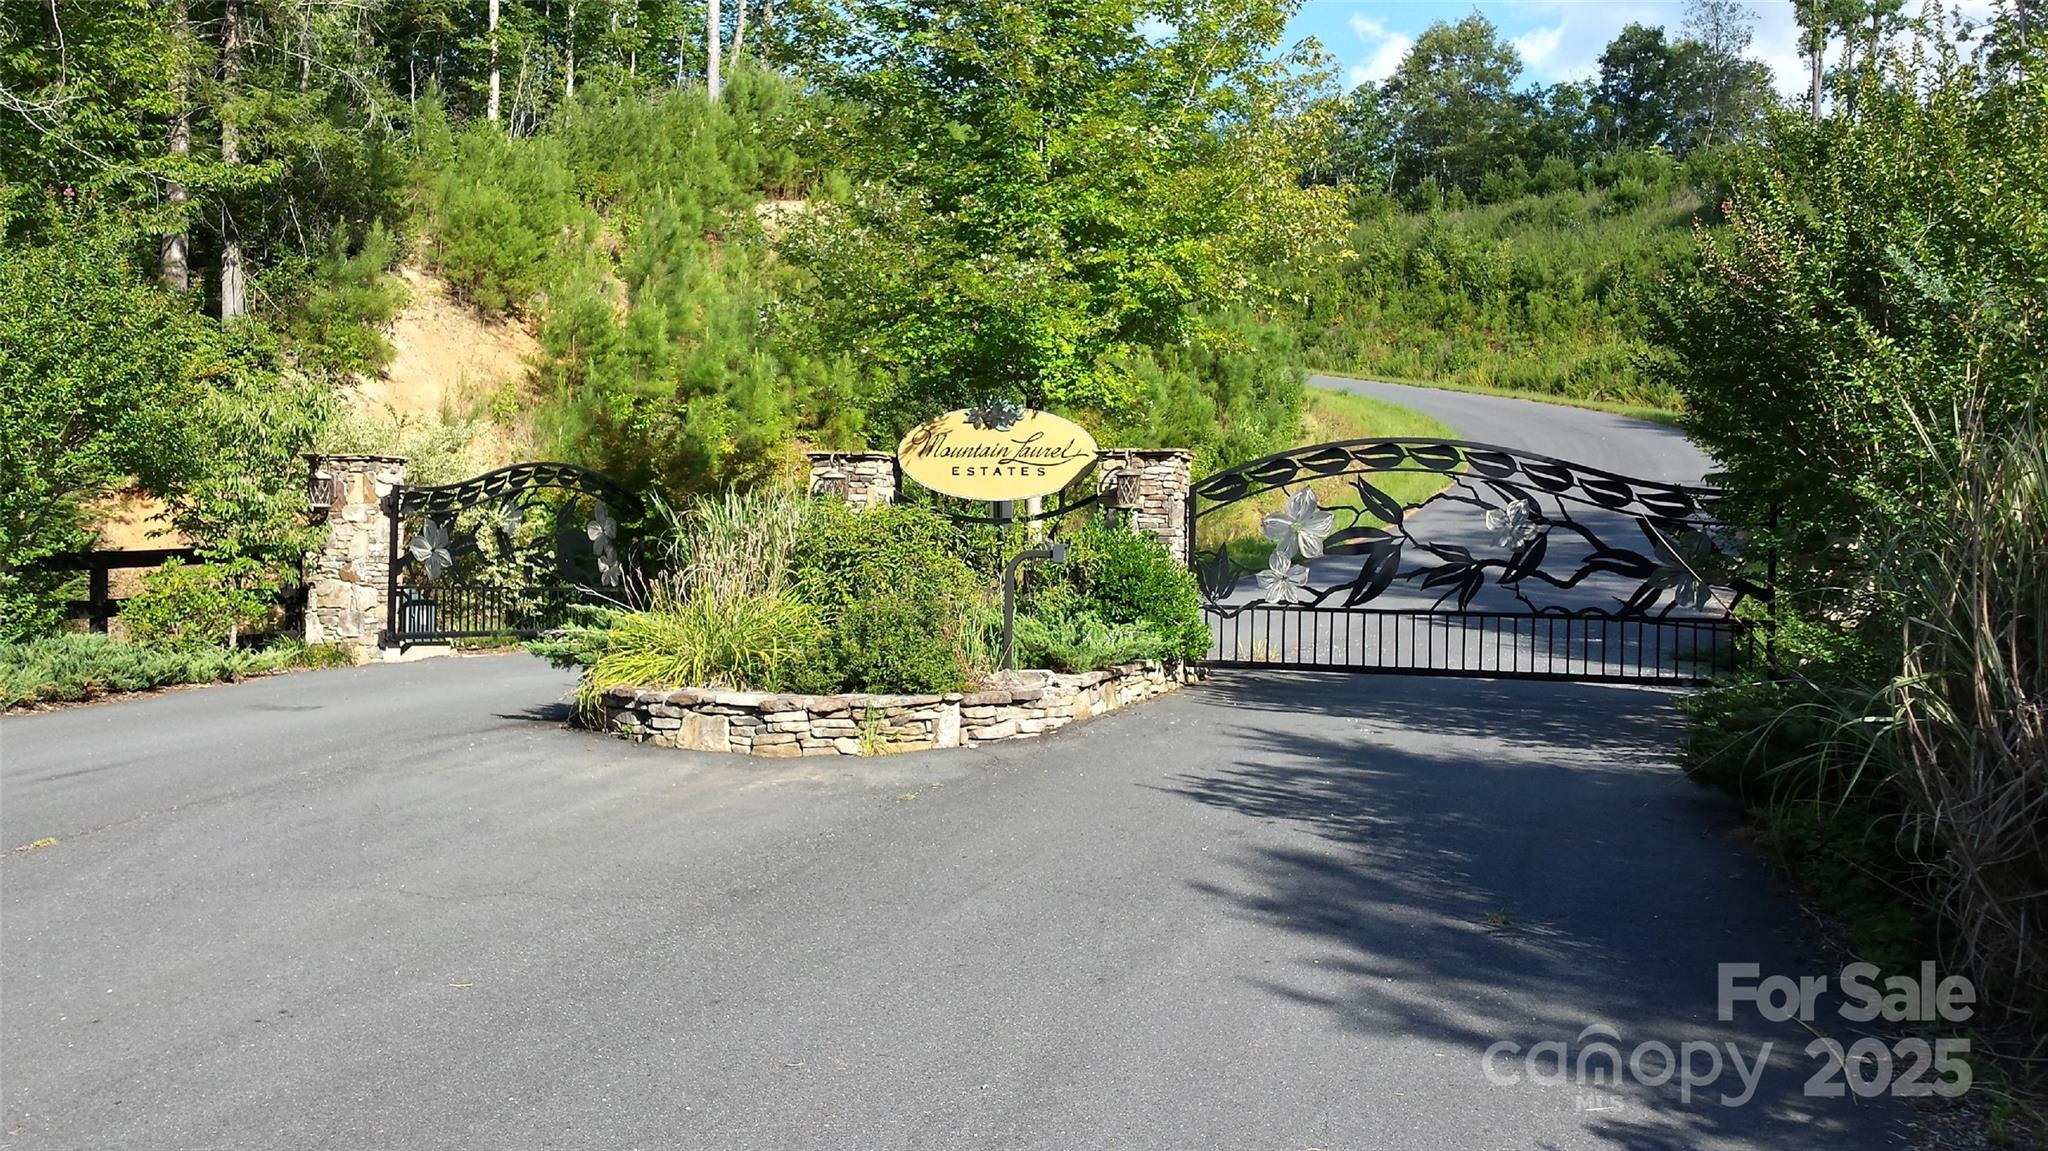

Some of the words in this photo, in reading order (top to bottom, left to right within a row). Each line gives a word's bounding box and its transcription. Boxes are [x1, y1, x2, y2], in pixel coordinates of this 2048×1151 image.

[912, 429, 1011, 458] Mountain
[998, 432, 1089, 466] Laurel
[952, 466, 1046, 477] ESTATES
